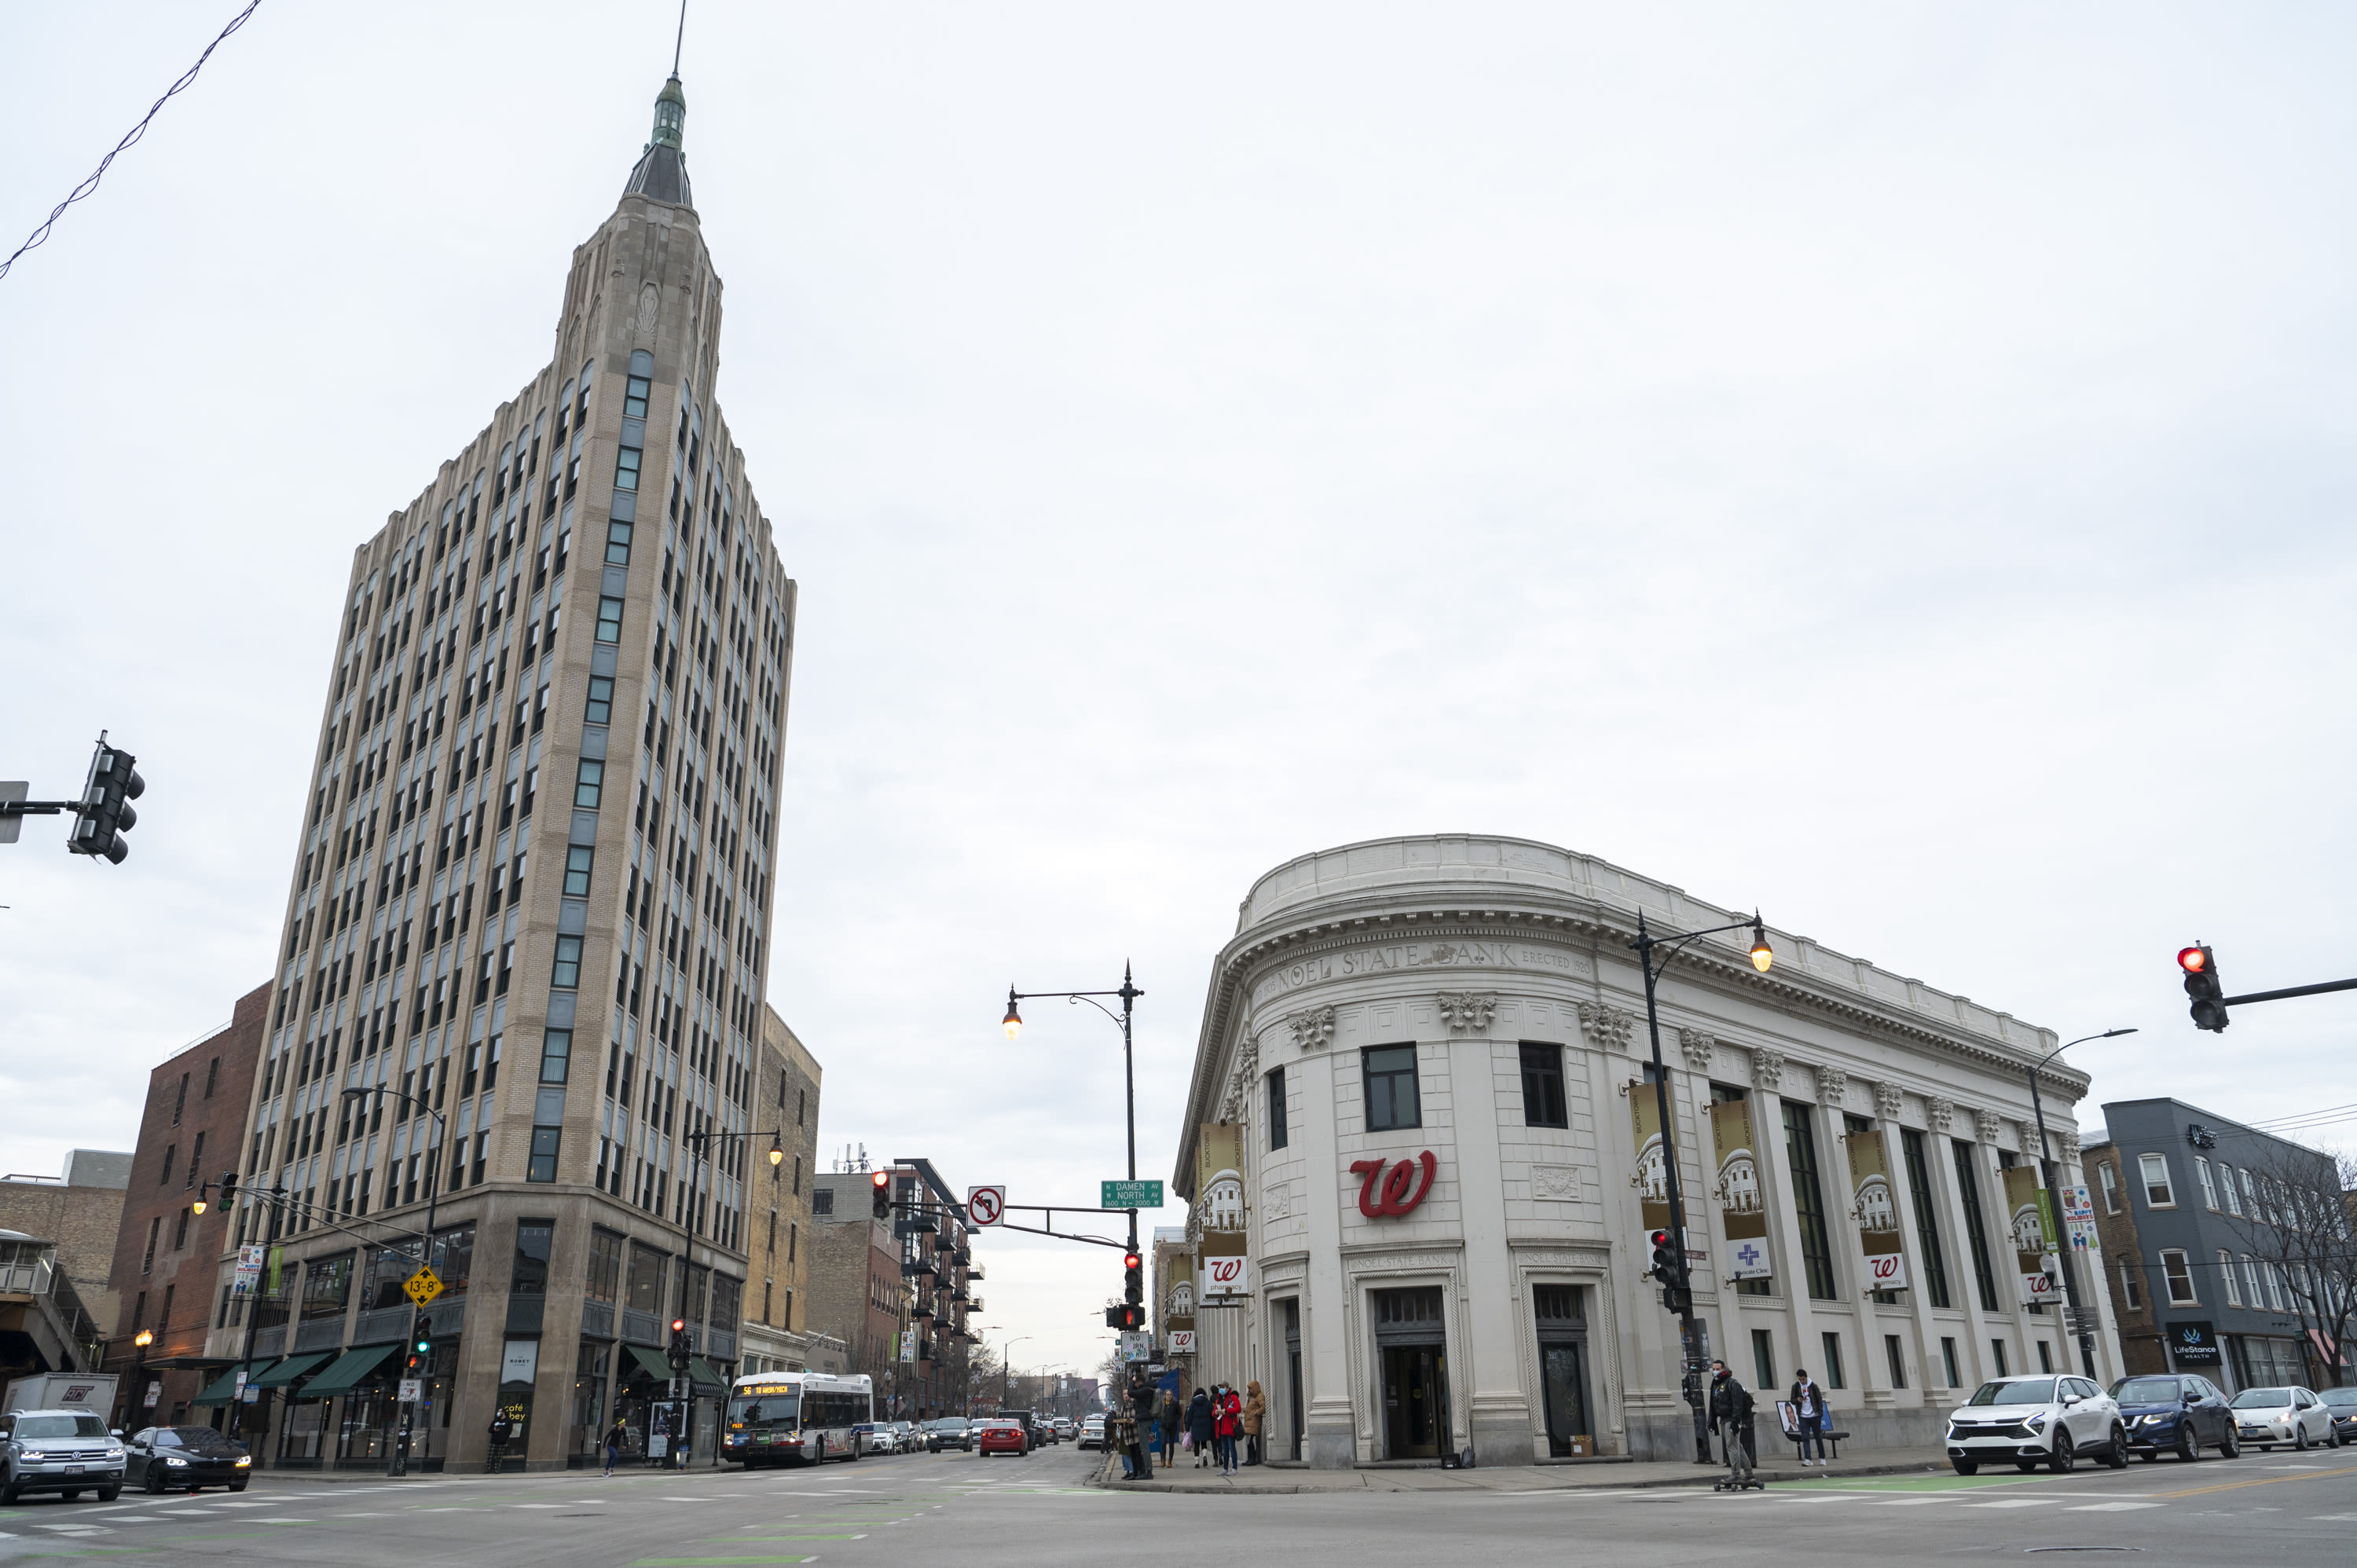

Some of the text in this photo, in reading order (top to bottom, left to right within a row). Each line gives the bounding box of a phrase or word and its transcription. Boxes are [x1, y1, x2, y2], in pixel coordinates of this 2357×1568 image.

[1277, 958, 1332, 993] NOEL
[1343, 945, 1420, 975] STATE
[1437, 943, 1517, 967] BANK
[1523, 951, 1570, 969] ERECTED
[1574, 960, 1591, 974] 1920
[1633, 1094, 1642, 1134] BUCKTOWN
[1743, 1121, 1752, 1146] WICKER
[1849, 1142, 1858, 1175] BUCKTOWN
[1875, 1132, 1886, 1172] WICKER PARK
[1116, 1182, 1145, 1191] DAMEN
[1117, 1191, 1145, 1200] NORTH
[1358, 1255, 1448, 1269] NOEL STATE BANK
[1526, 1253, 1551, 1262] NOEL
[1553, 1254, 1577, 1264] STATE
[1285, 1266, 1301, 1277] BANK
[409, 1280, 438, 1292] 13'-8"
[62, 1386, 94, 1401] ACT
[743, 1387, 752, 1395] 56
[509, 1412, 526, 1421] bey
